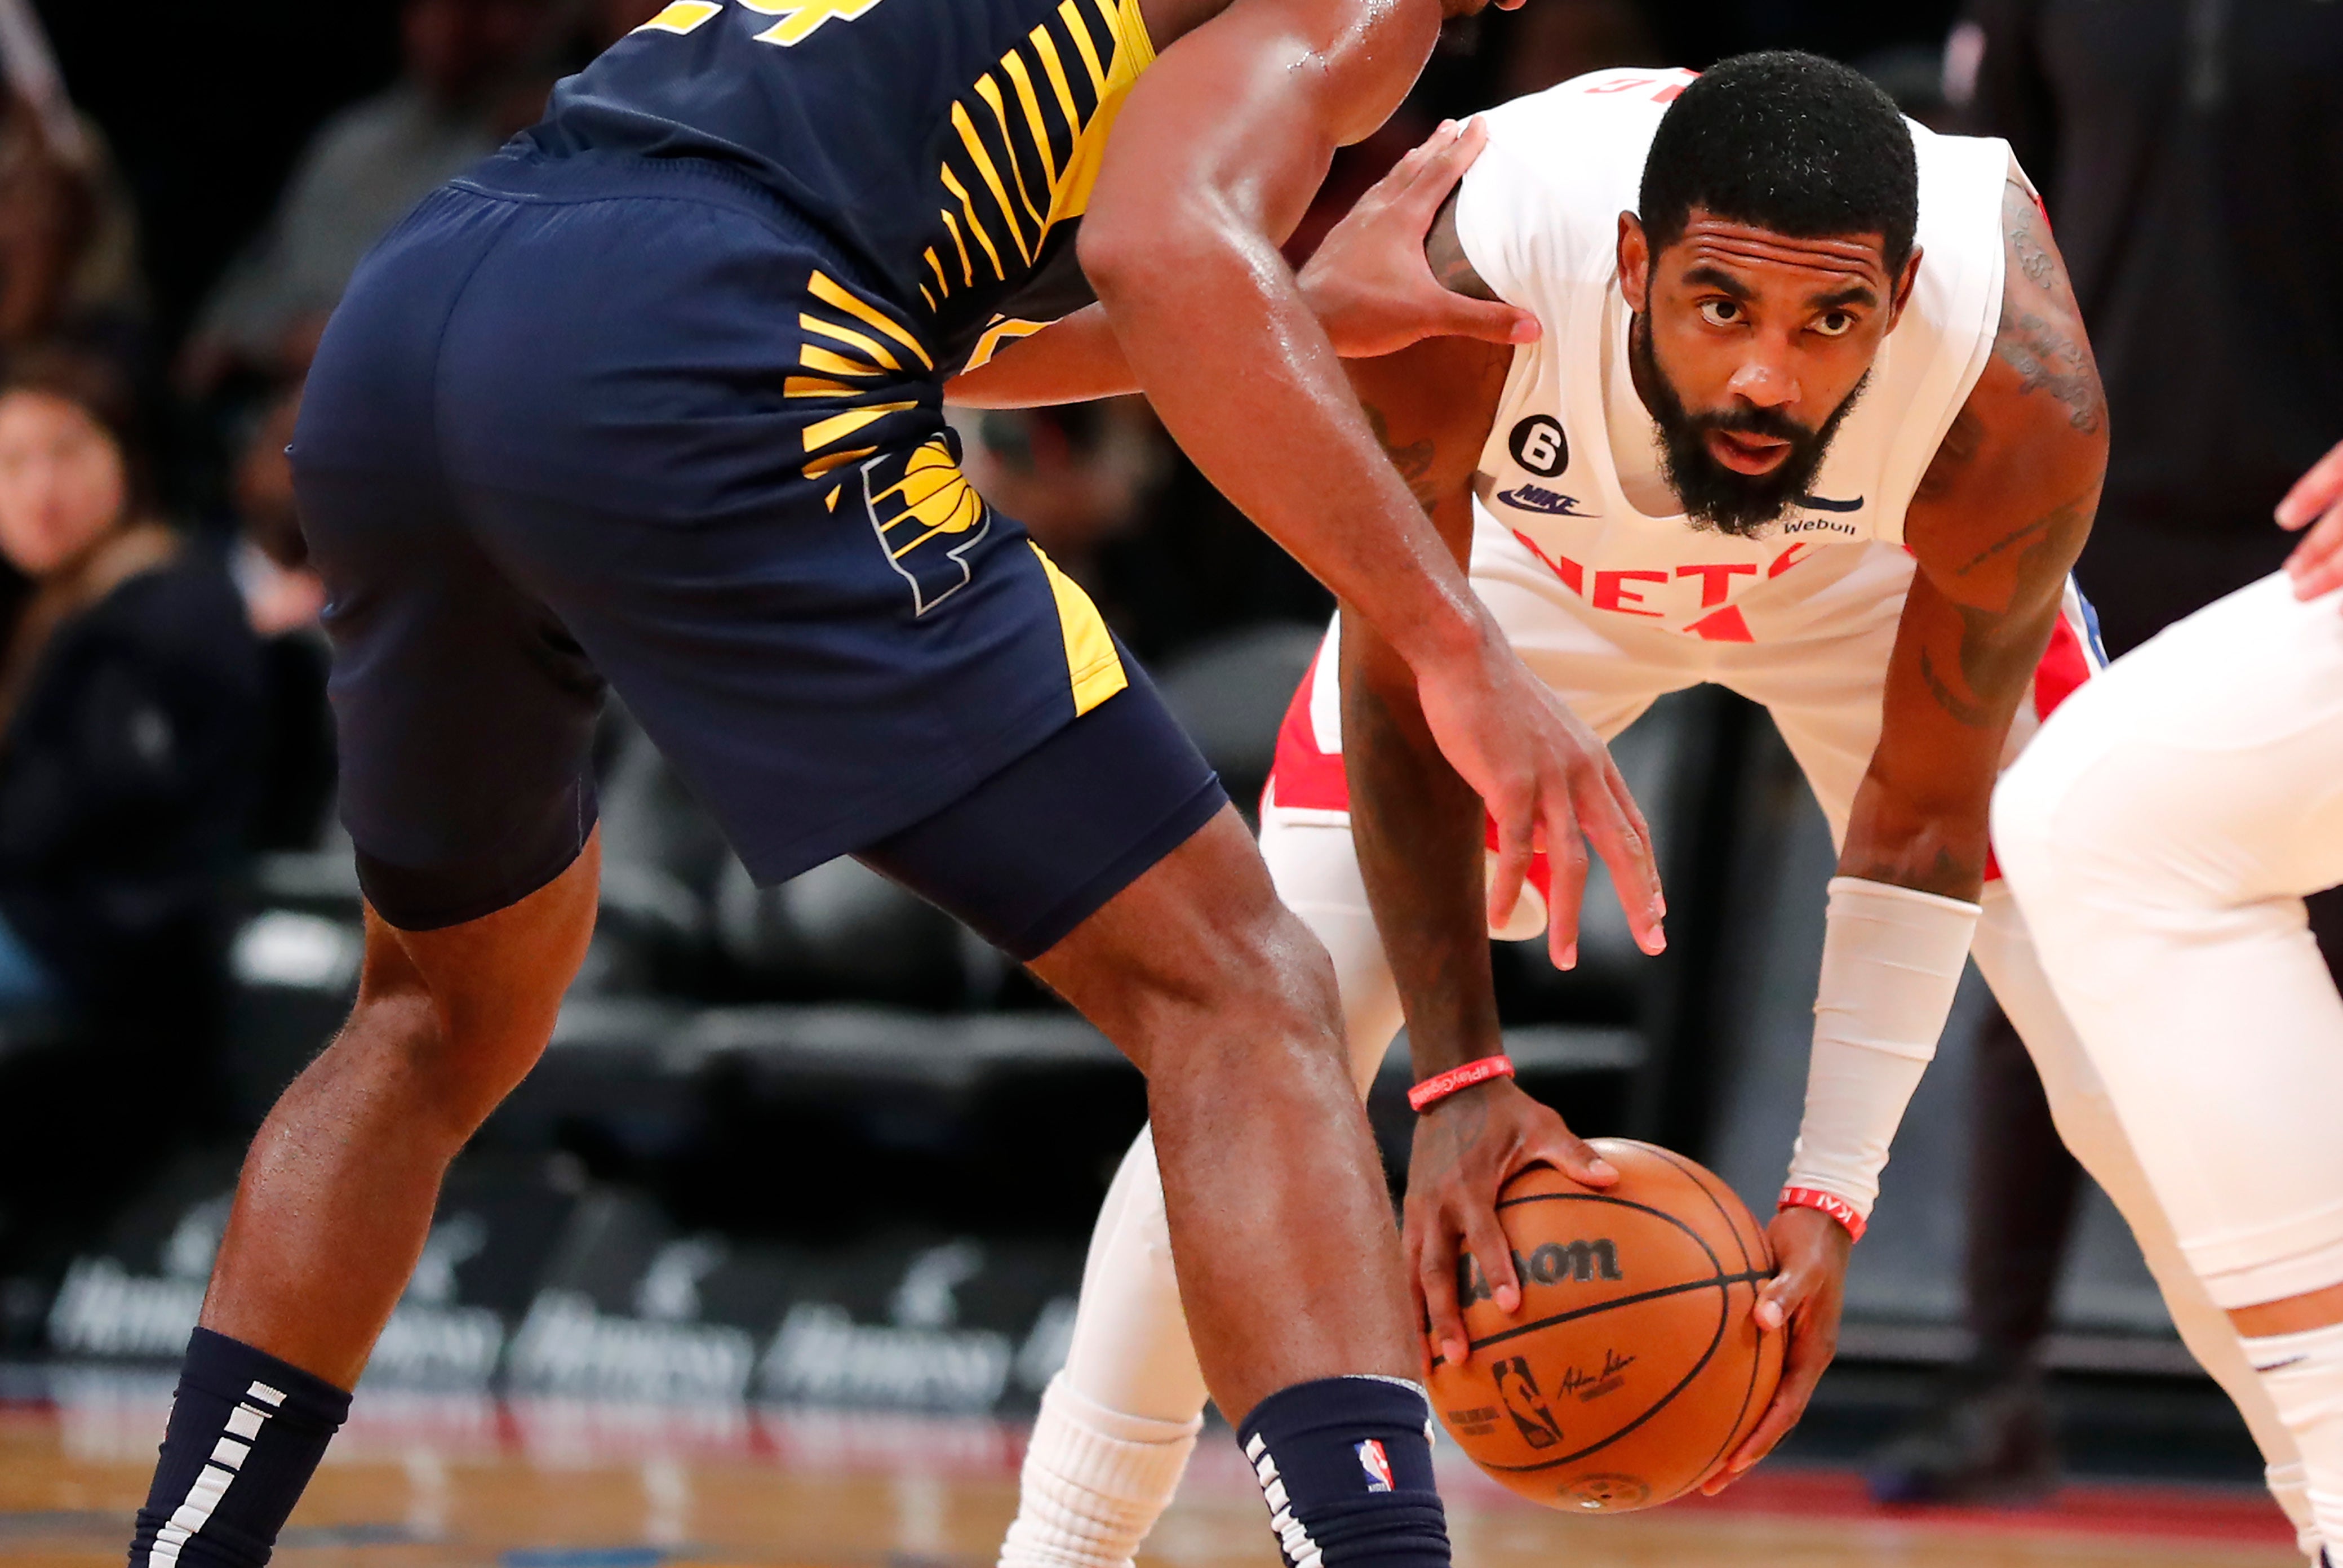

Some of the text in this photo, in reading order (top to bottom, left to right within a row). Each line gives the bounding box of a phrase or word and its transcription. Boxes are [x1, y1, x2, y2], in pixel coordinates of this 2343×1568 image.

[1521, 422, 1562, 471] 6
[1514, 483, 1581, 513] NIKE
[1784, 518, 1856, 536] Webull
